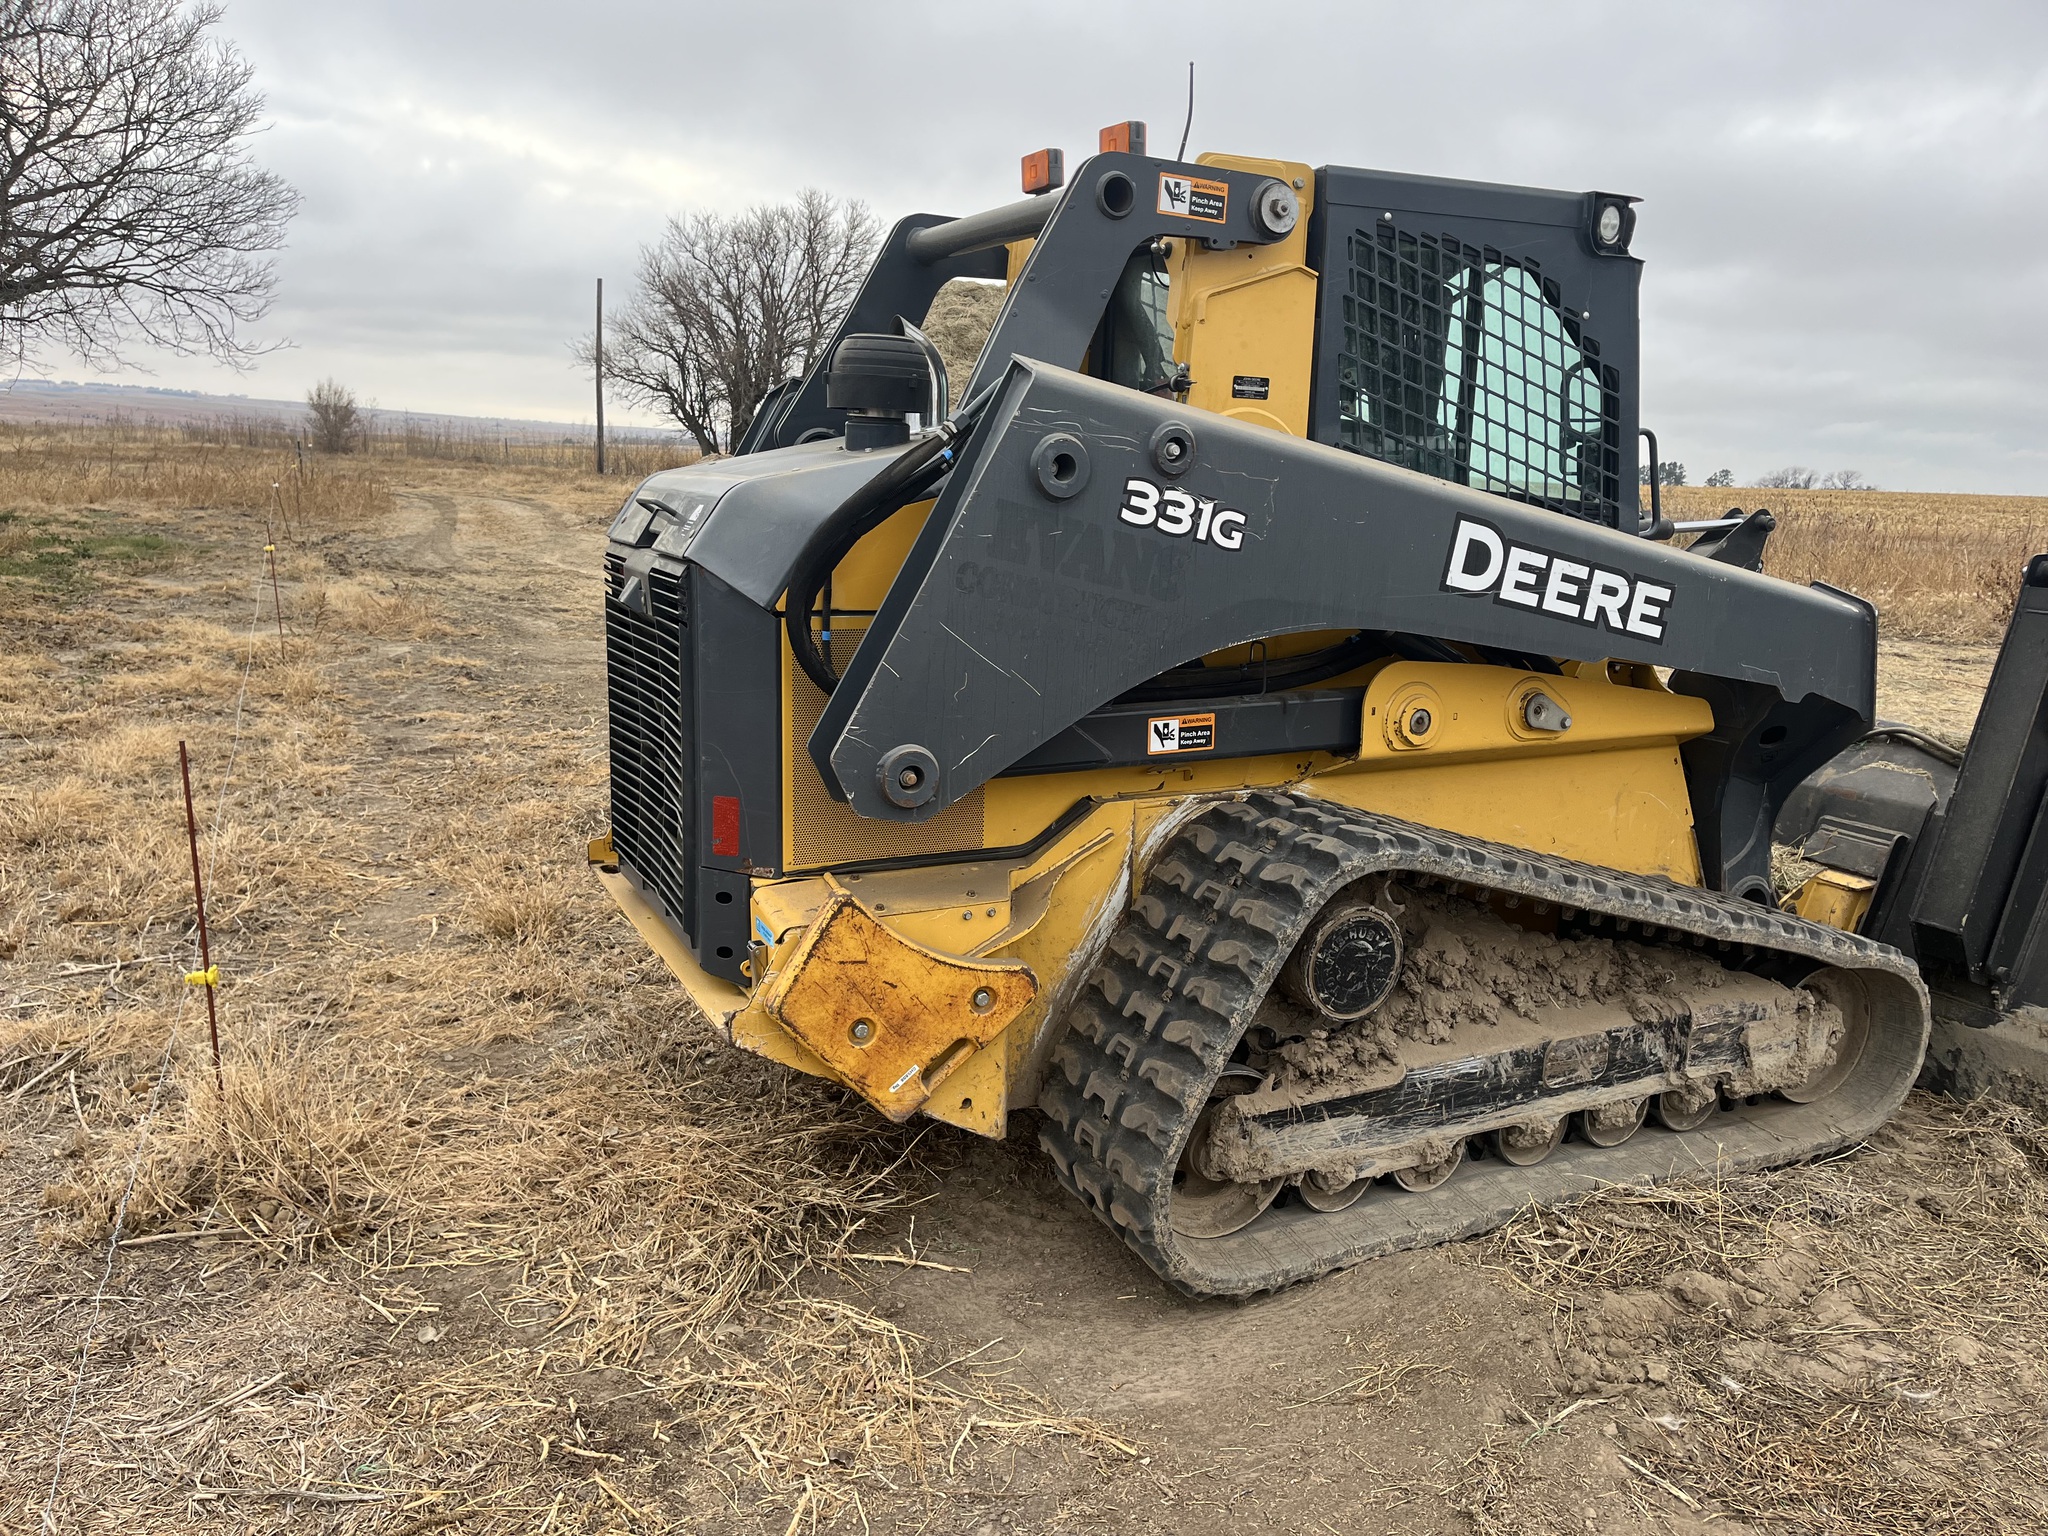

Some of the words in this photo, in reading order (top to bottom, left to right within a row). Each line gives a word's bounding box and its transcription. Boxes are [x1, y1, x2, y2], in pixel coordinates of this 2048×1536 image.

[1199, 183, 1225, 193] WARNING
[1192, 196, 1208, 205] Pinch
[1209, 199, 1222, 207] Area
[1191, 205, 1204, 213] Keep
[1120, 480, 1246, 549] 331G
[1445, 519, 1673, 639] DEERE
